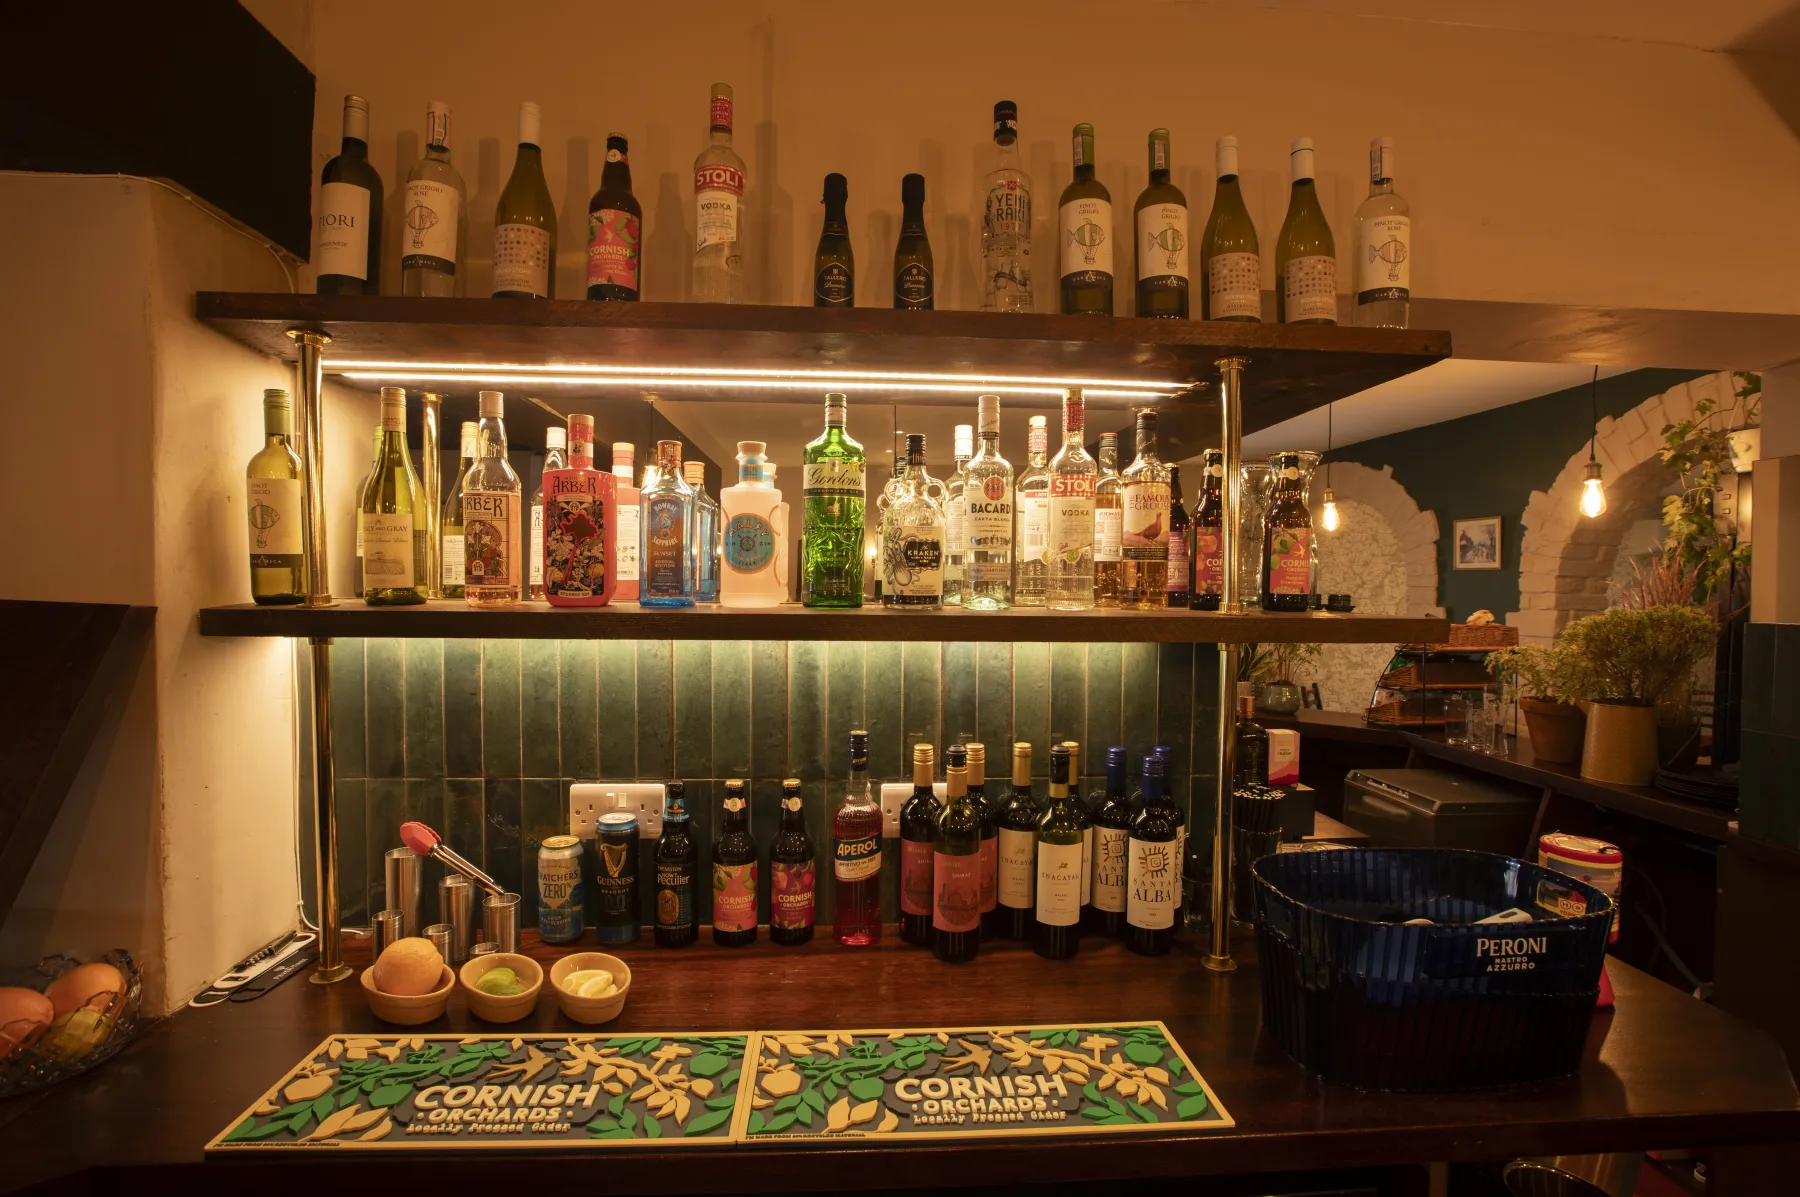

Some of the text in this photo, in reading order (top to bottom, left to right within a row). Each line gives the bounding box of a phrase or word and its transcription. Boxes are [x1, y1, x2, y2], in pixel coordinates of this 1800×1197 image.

[696, 170, 739, 187] STOLI
[700, 202, 732, 211] VODKA
[590, 245, 630, 257] CORNISH
[808, 467, 861, 487] Gordon's
[552, 476, 597, 494] ARBER
[1055, 479, 1095, 492] STOLI
[1135, 493, 1170, 502] FAMOUS
[466, 497, 503, 517] RBER
[653, 503, 679, 514] BOMBAY
[1135, 502, 1170, 511] GROUSE
[652, 535, 679, 547] SAPPHIRE
[837, 838, 878, 857] APEROL
[596, 874, 637, 886] GUINNESS
[1133, 877, 1171, 888] SANTA
[718, 893, 754, 904] CORNISH
[778, 891, 812, 902] CORNISH
[1132, 887, 1172, 903] ALBA
[783, 899, 809, 907] ORCHARDS
[1476, 936, 1548, 957] PERONI
[1494, 956, 1528, 964] NASTRO
[1486, 962, 1536, 972] AZZURRO
[894, 1073, 1068, 1102] CORNISH
[414, 1084, 601, 1110] CORNISH
[923, 1096, 1047, 1115] ORCHARDS
[428, 1107, 562, 1124] ORCHARDS
[913, 1111, 1066, 1125] Locally Pressed Cider
[405, 1122, 571, 1135] Locally Pressed Cider
